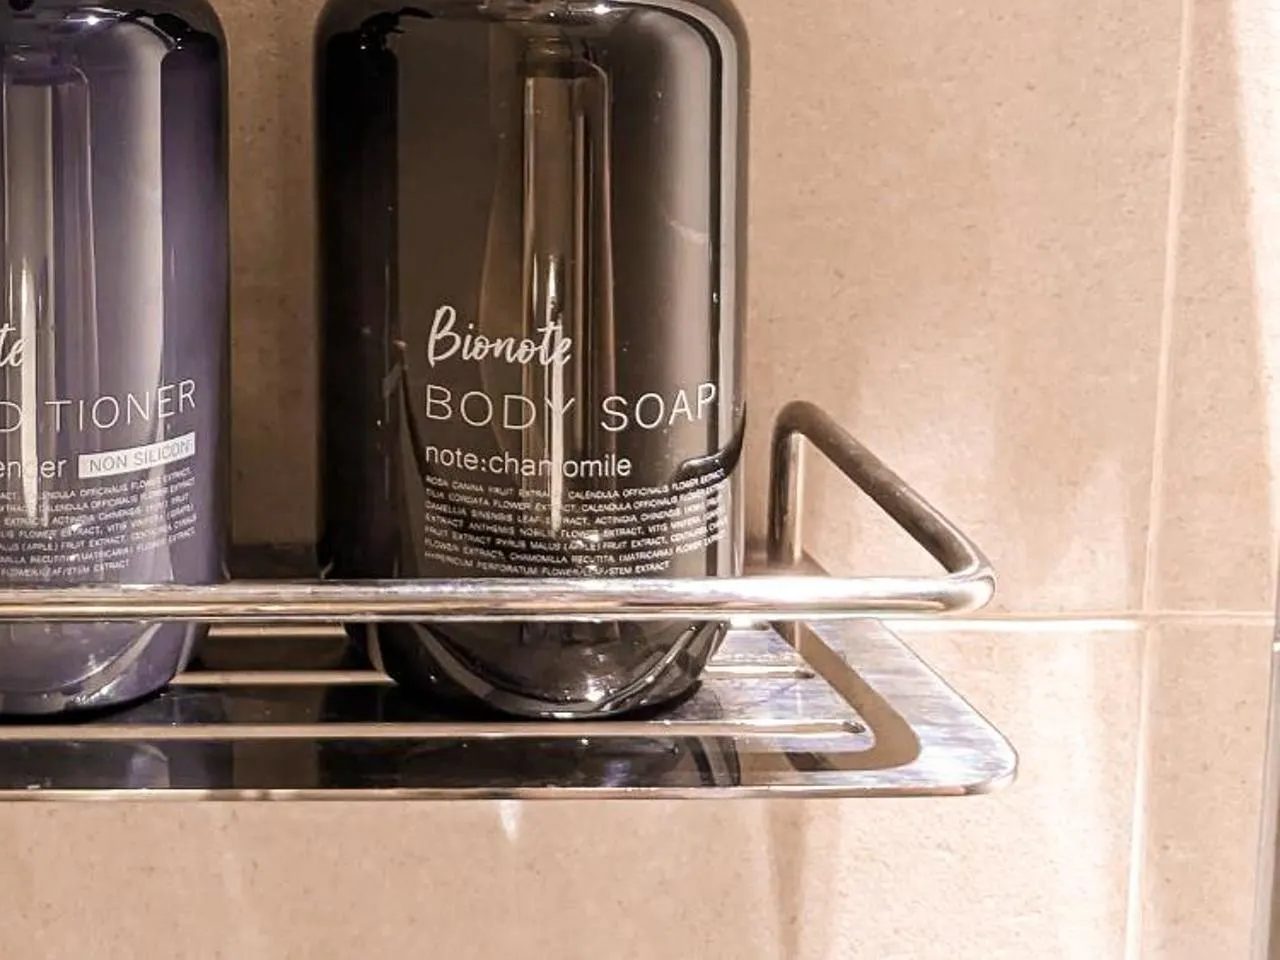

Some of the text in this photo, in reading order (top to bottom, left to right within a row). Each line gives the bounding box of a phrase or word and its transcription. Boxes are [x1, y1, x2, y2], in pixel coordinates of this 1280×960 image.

[428, 305, 572, 367] Bionote
[425, 382, 717, 432] BODY SOAP
[89, 437, 193, 474] NON SILICON
